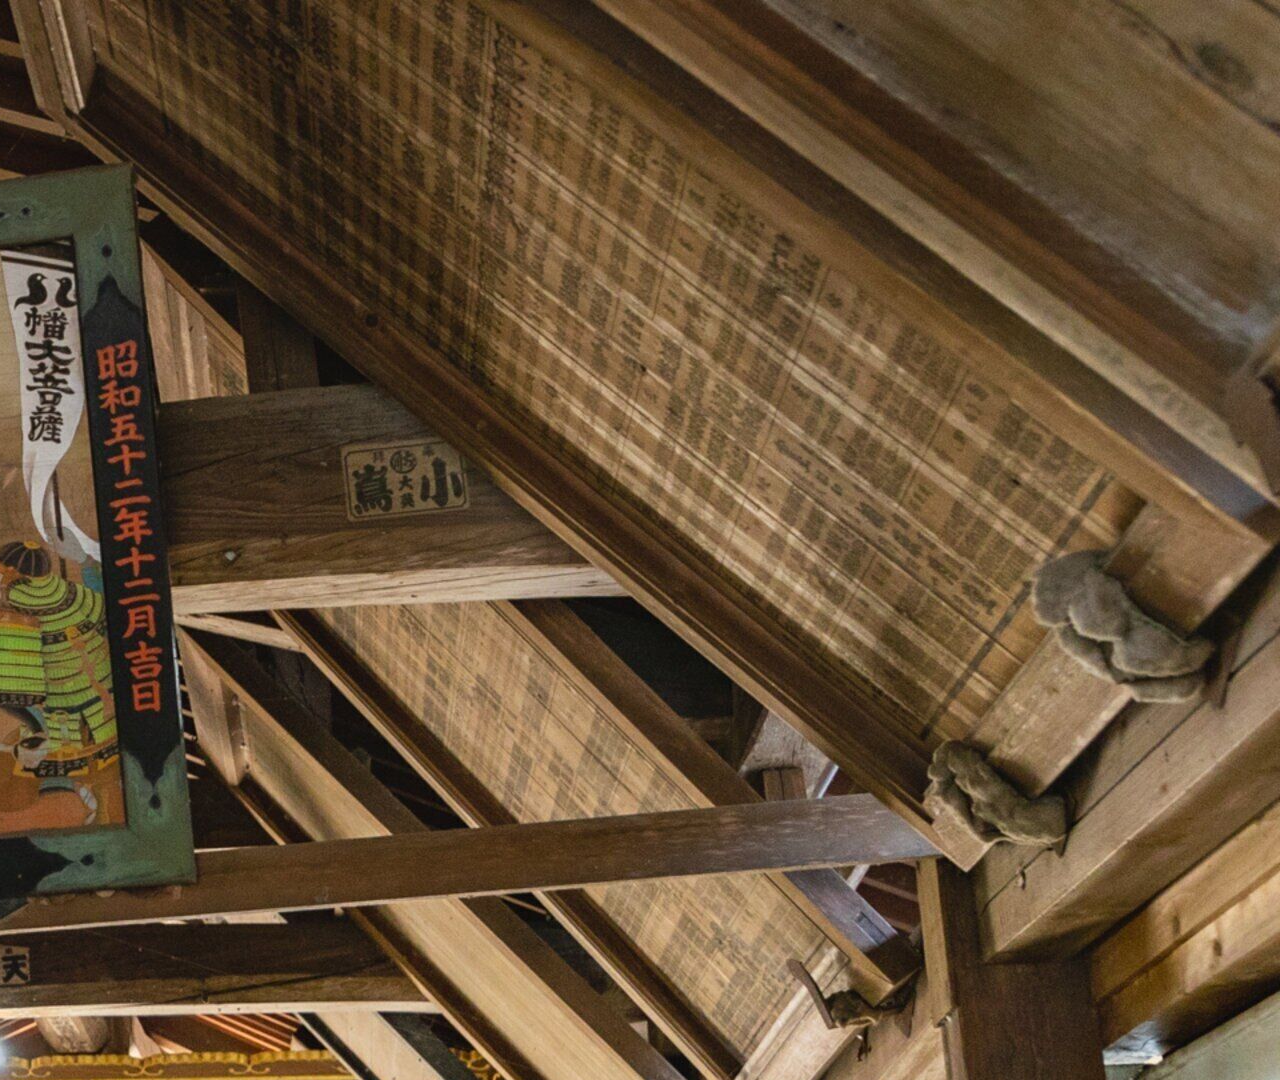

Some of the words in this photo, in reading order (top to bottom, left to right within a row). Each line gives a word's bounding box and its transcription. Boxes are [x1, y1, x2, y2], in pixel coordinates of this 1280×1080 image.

[96, 339, 163, 712] 昭和五十二年十二月吉日
